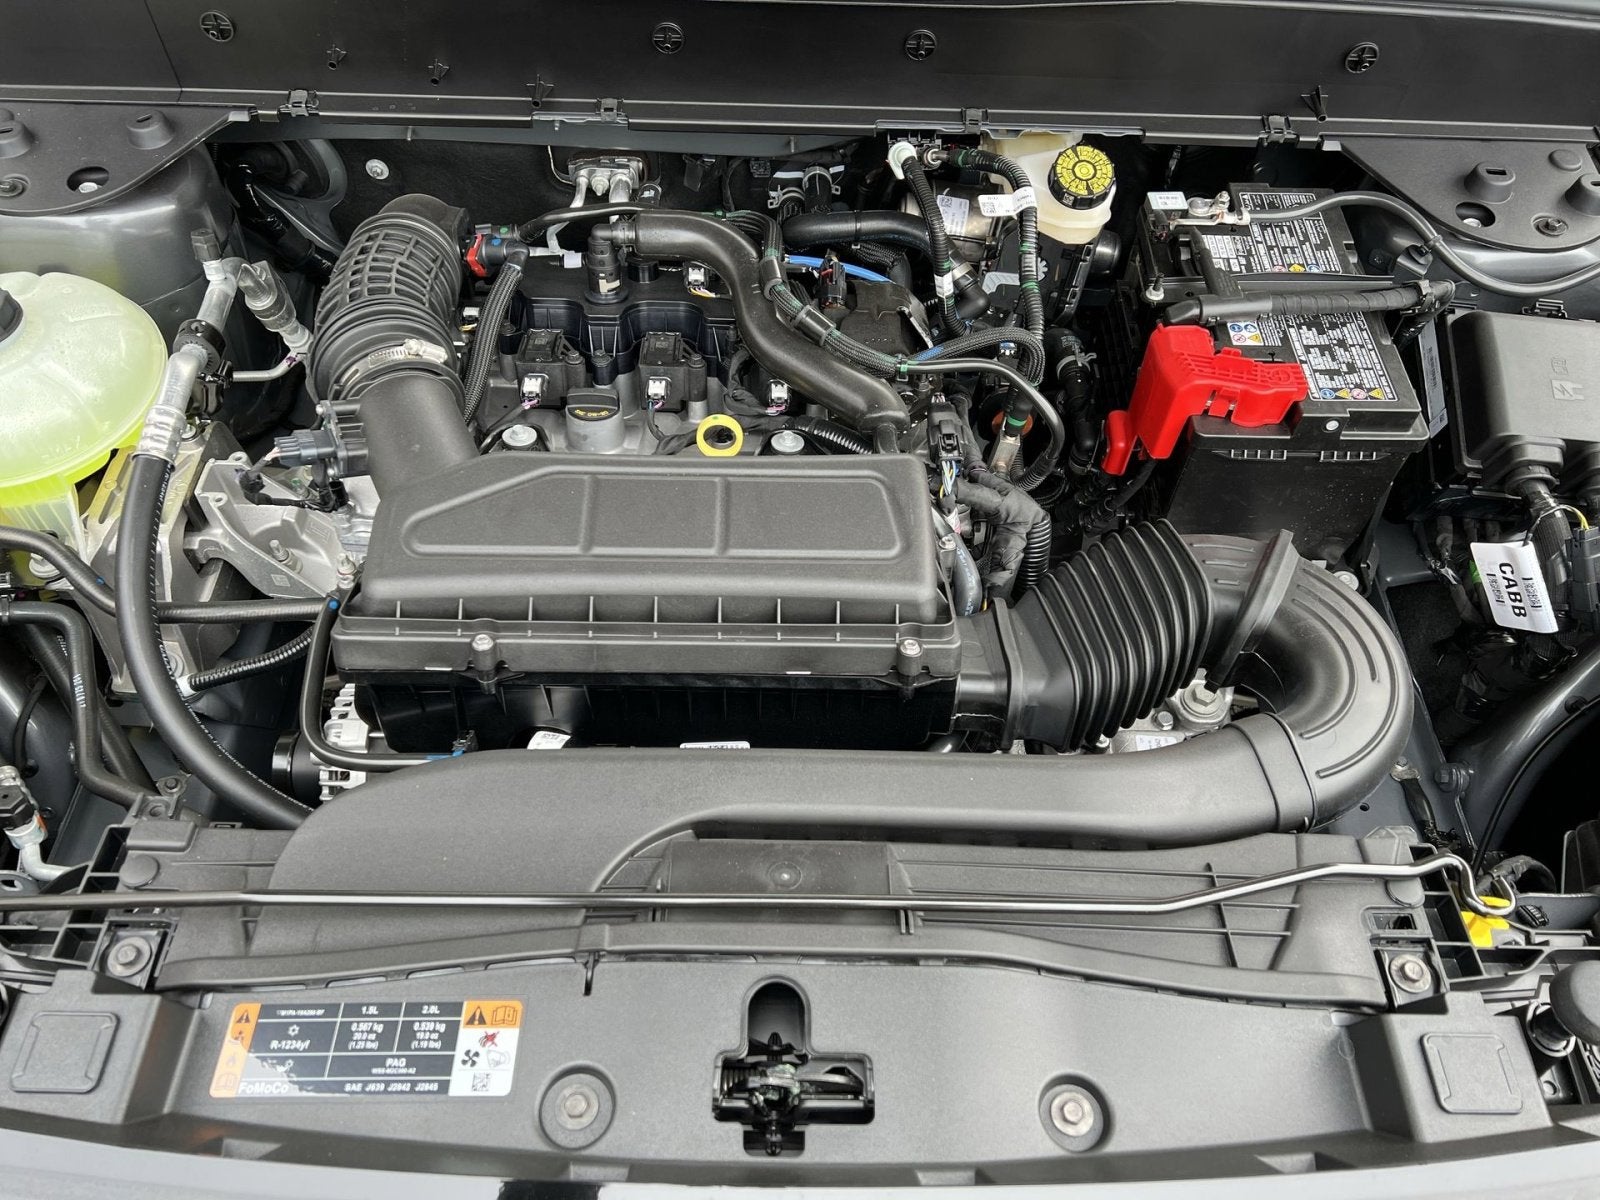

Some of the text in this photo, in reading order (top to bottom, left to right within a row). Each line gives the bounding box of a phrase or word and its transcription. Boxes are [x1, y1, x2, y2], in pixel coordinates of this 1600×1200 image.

[1499, 563, 1527, 617] CABB
[361, 1006, 379, 1015] 1.5L
[421, 1005, 440, 1015] 2.0L
[351, 1022, 384, 1034] 0.567 kg
[413, 1022, 446, 1033] 0.539 kg
[270, 1040, 311, 1051] R-1234yf
[385, 1058, 406, 1067] PAG
[238, 1082, 289, 1094] FoMoCo
[344, 1083, 362, 1092] SAE
[365, 1083, 385, 1092] J639
